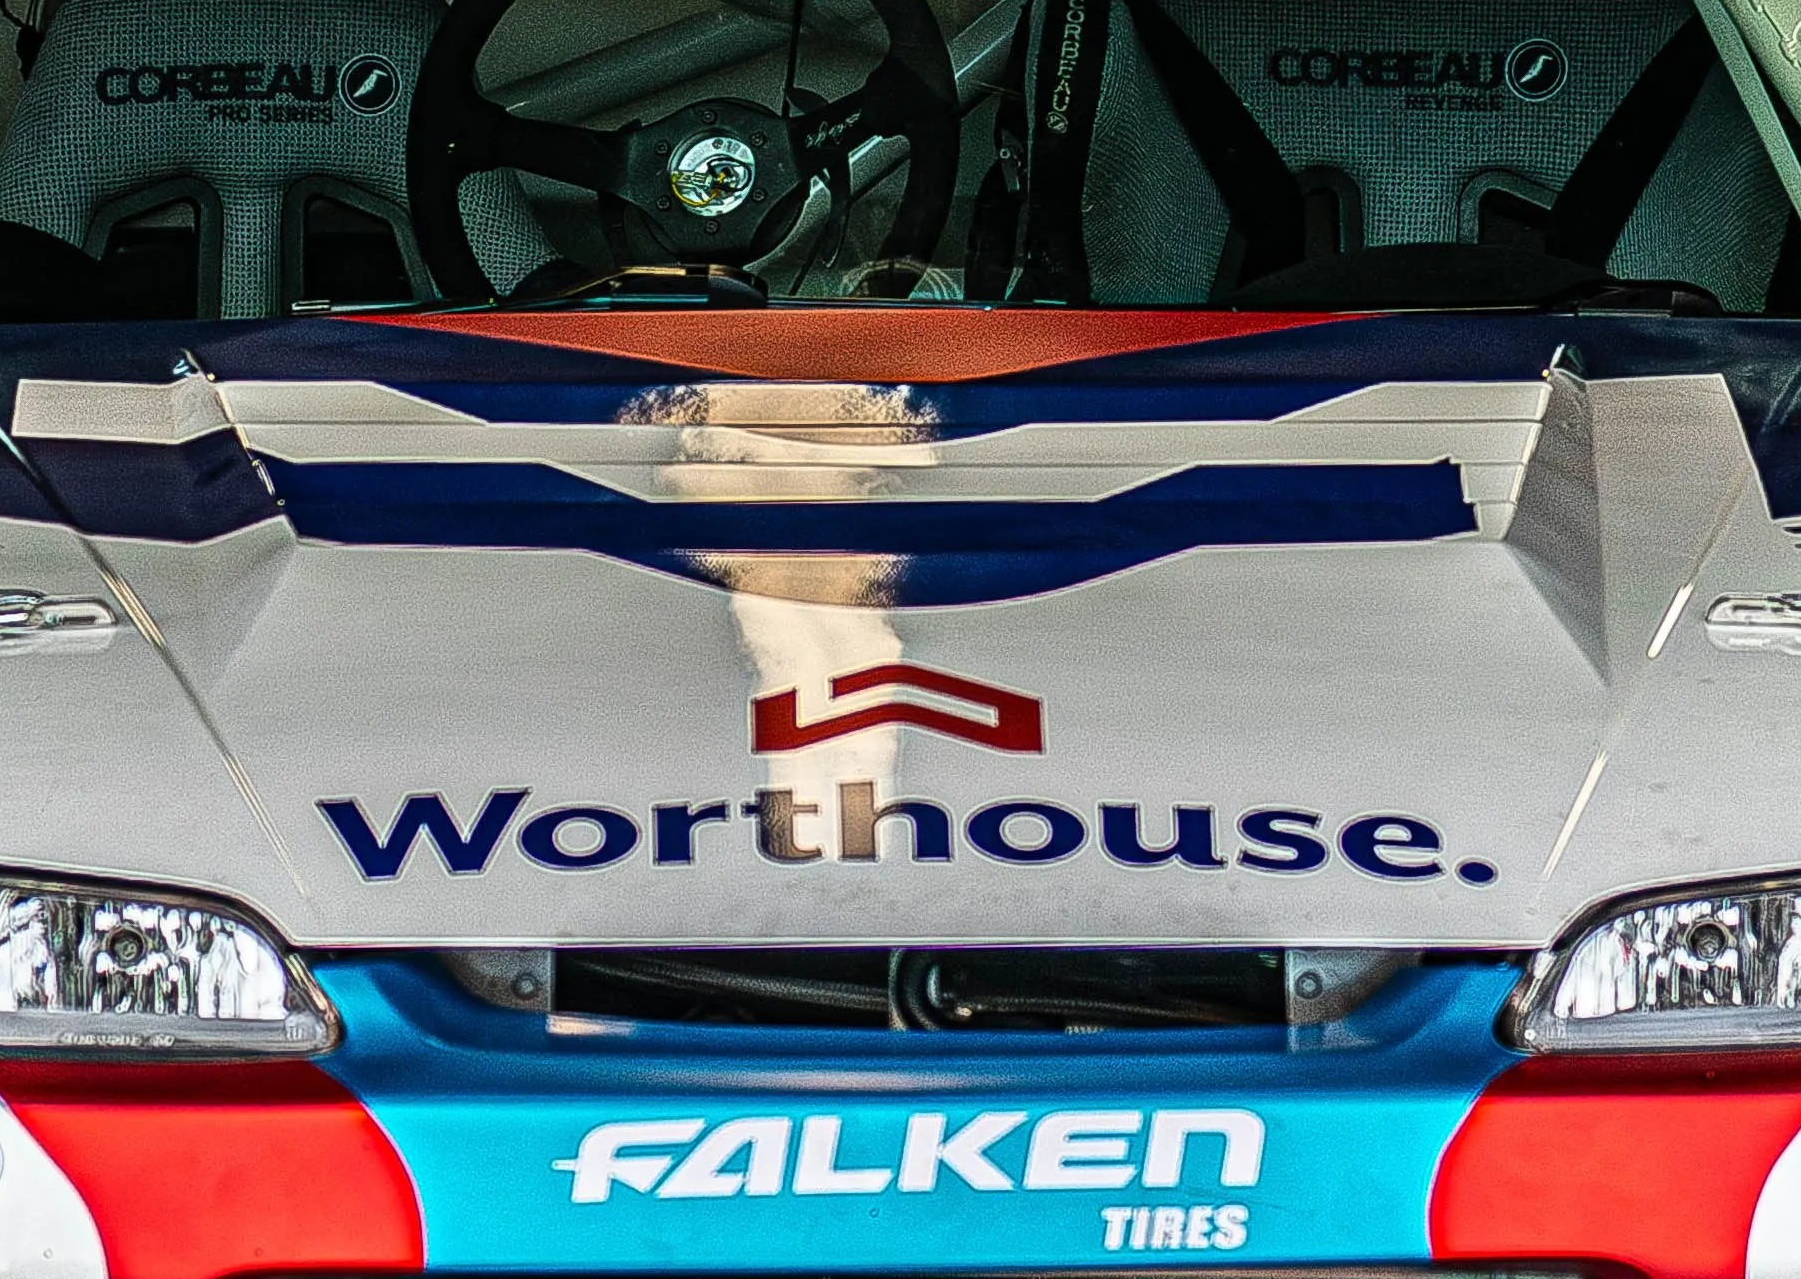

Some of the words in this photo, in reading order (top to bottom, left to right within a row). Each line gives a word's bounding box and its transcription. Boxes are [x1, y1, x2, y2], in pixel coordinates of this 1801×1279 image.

[96, 62, 337, 105] CORBEAU
[1269, 49, 1504, 89] CORBEAU
[207, 105, 250, 122] PRO
[260, 105, 334, 124] SERIES
[1404, 93, 1504, 112] REVENGE
[313, 781, 1501, 887] Worthouse.
[551, 1107, 1267, 1204] FALKEN
[1099, 1204, 1251, 1252] TIRES
